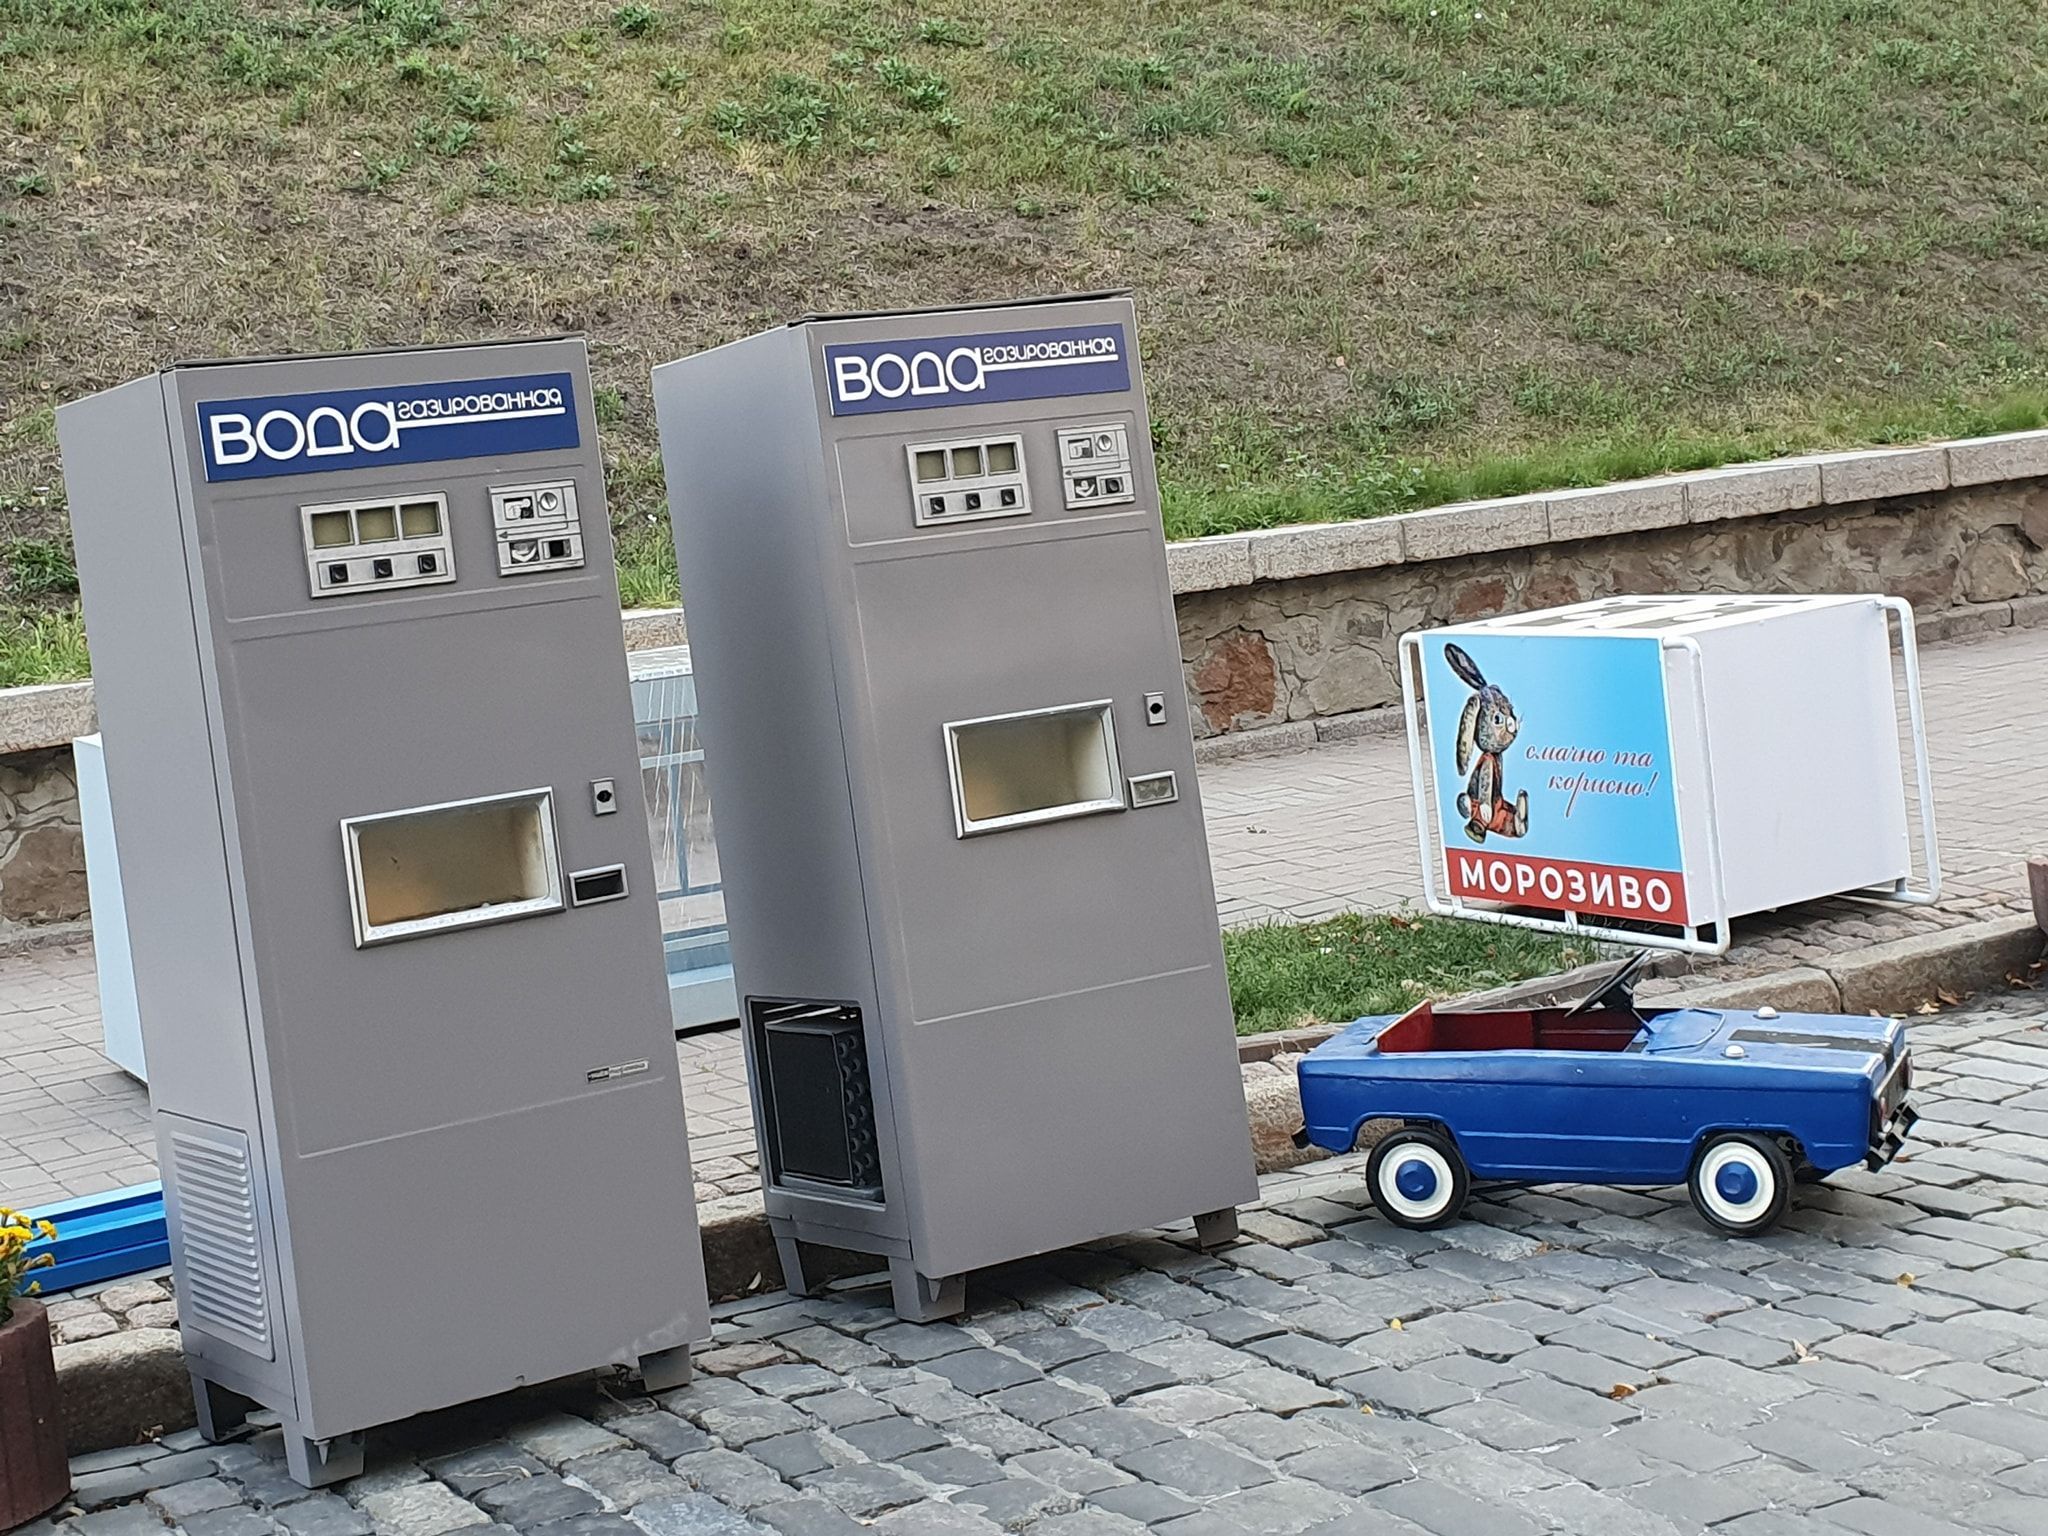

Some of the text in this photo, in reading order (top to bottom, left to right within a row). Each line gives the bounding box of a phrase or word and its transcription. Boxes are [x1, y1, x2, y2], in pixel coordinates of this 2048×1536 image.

[1525, 745, 1653, 768] смачно та
[1548, 771, 1659, 818] корисно!
[1459, 857, 1672, 913] МОРОЗИВО
